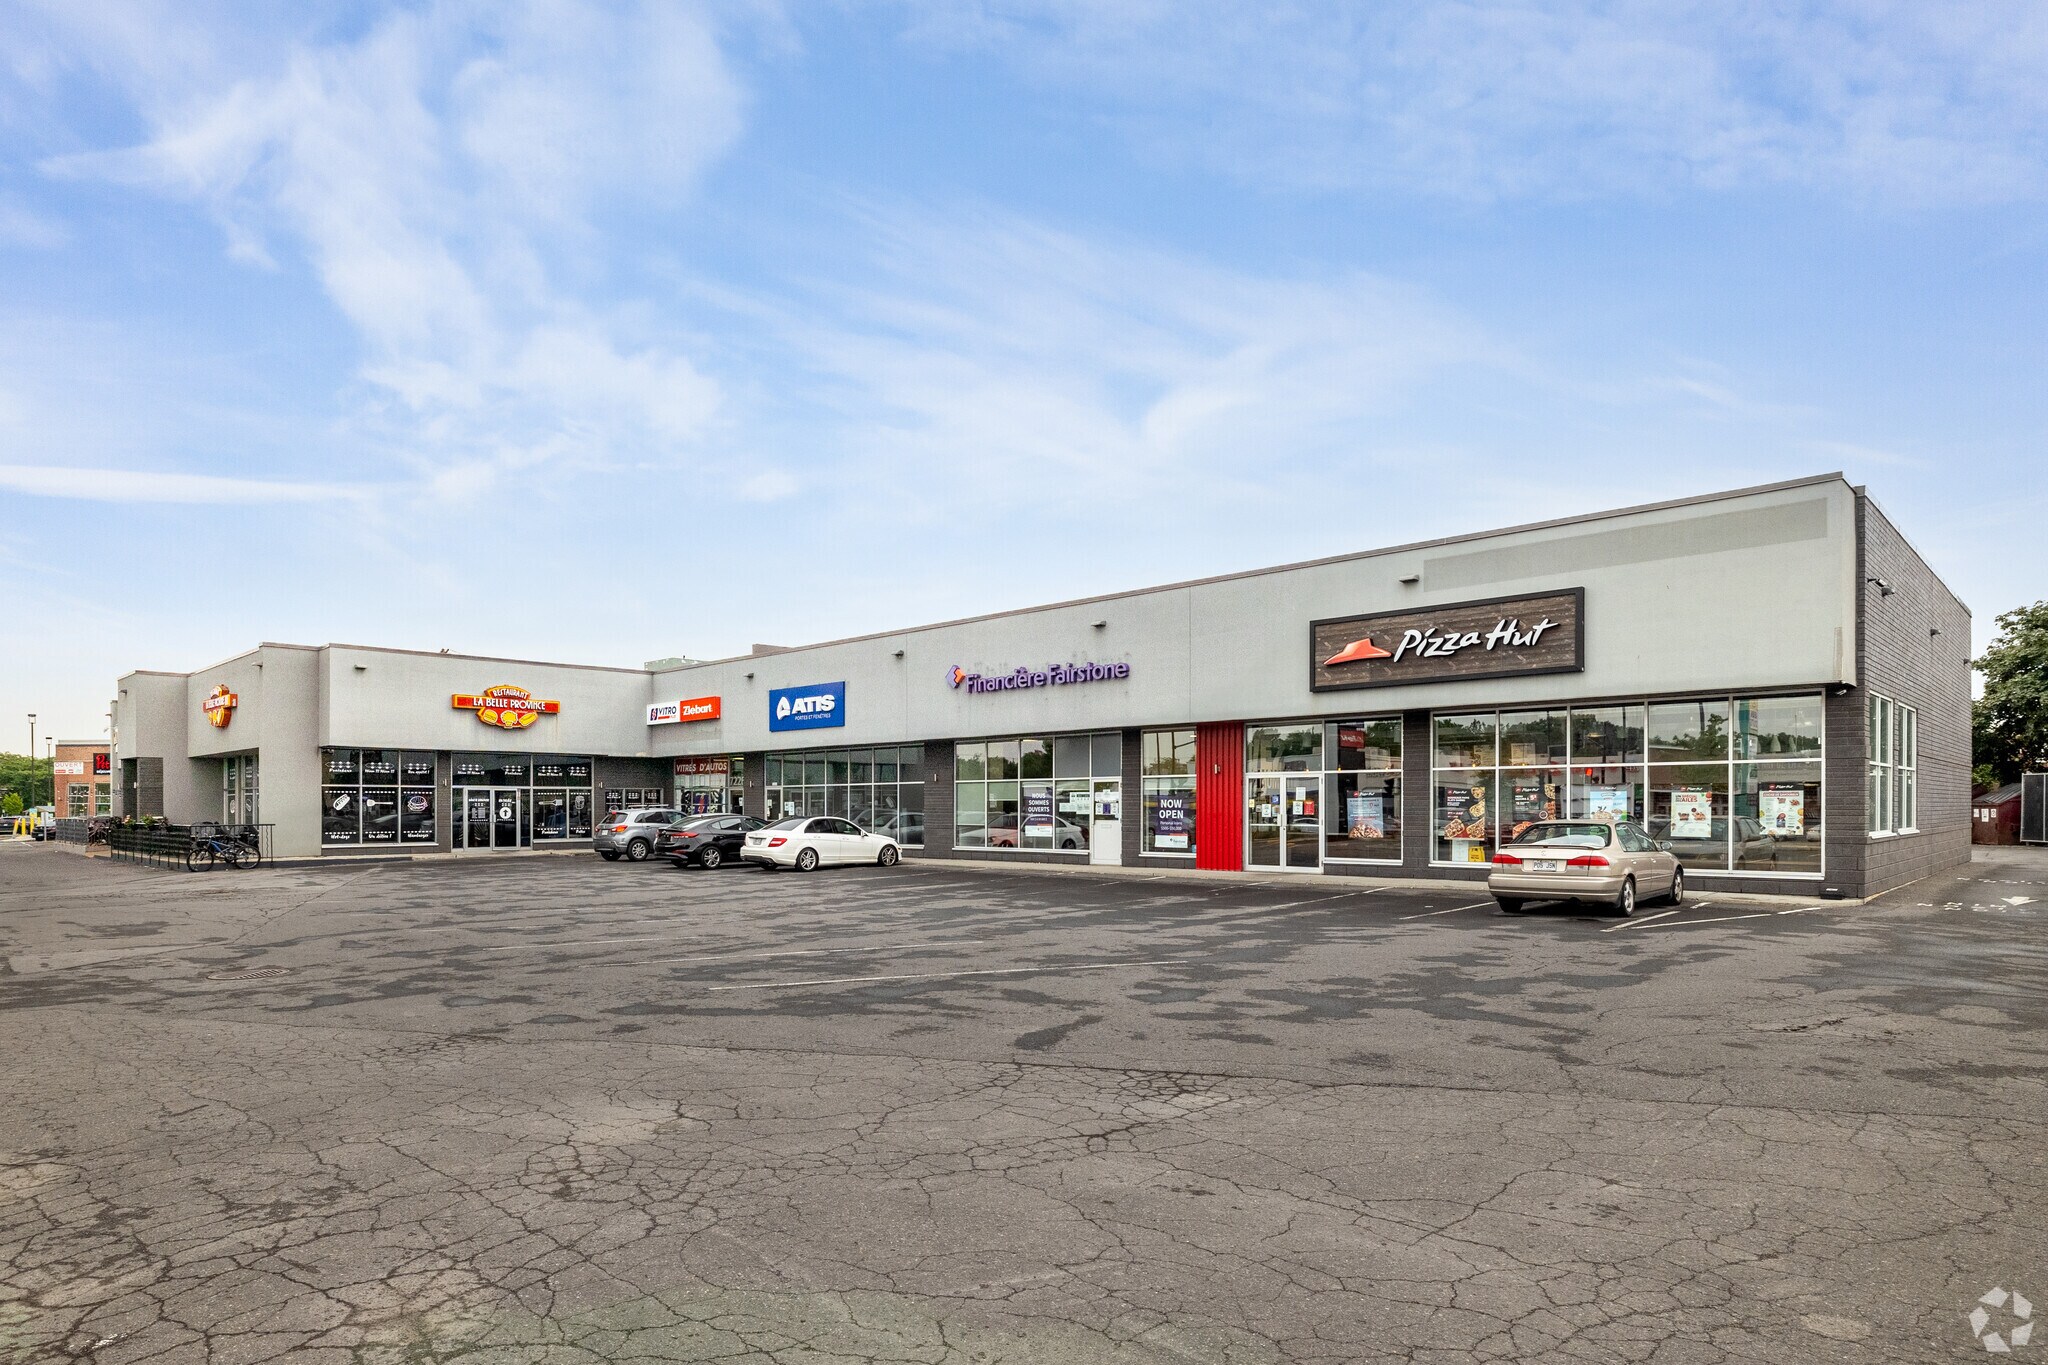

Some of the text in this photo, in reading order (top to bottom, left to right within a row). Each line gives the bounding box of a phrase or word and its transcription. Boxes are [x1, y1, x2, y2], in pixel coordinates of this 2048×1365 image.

[1393, 618, 1560, 662] Pizza Hut
[965, 661, 1130, 693] Financière Fairstone
[492, 688, 528, 699] RESTAURANT
[473, 697, 546, 710] LA BELLE PROVINCE
[791, 694, 835, 714] ATIS
[658, 706, 677, 715] VITRO
[682, 704, 712, 716] Ziebart
[676, 762, 728, 772] VITRES D'AUTOS
[1160, 799, 1183, 808] NOW
[1159, 810, 1184, 818] OPEN
